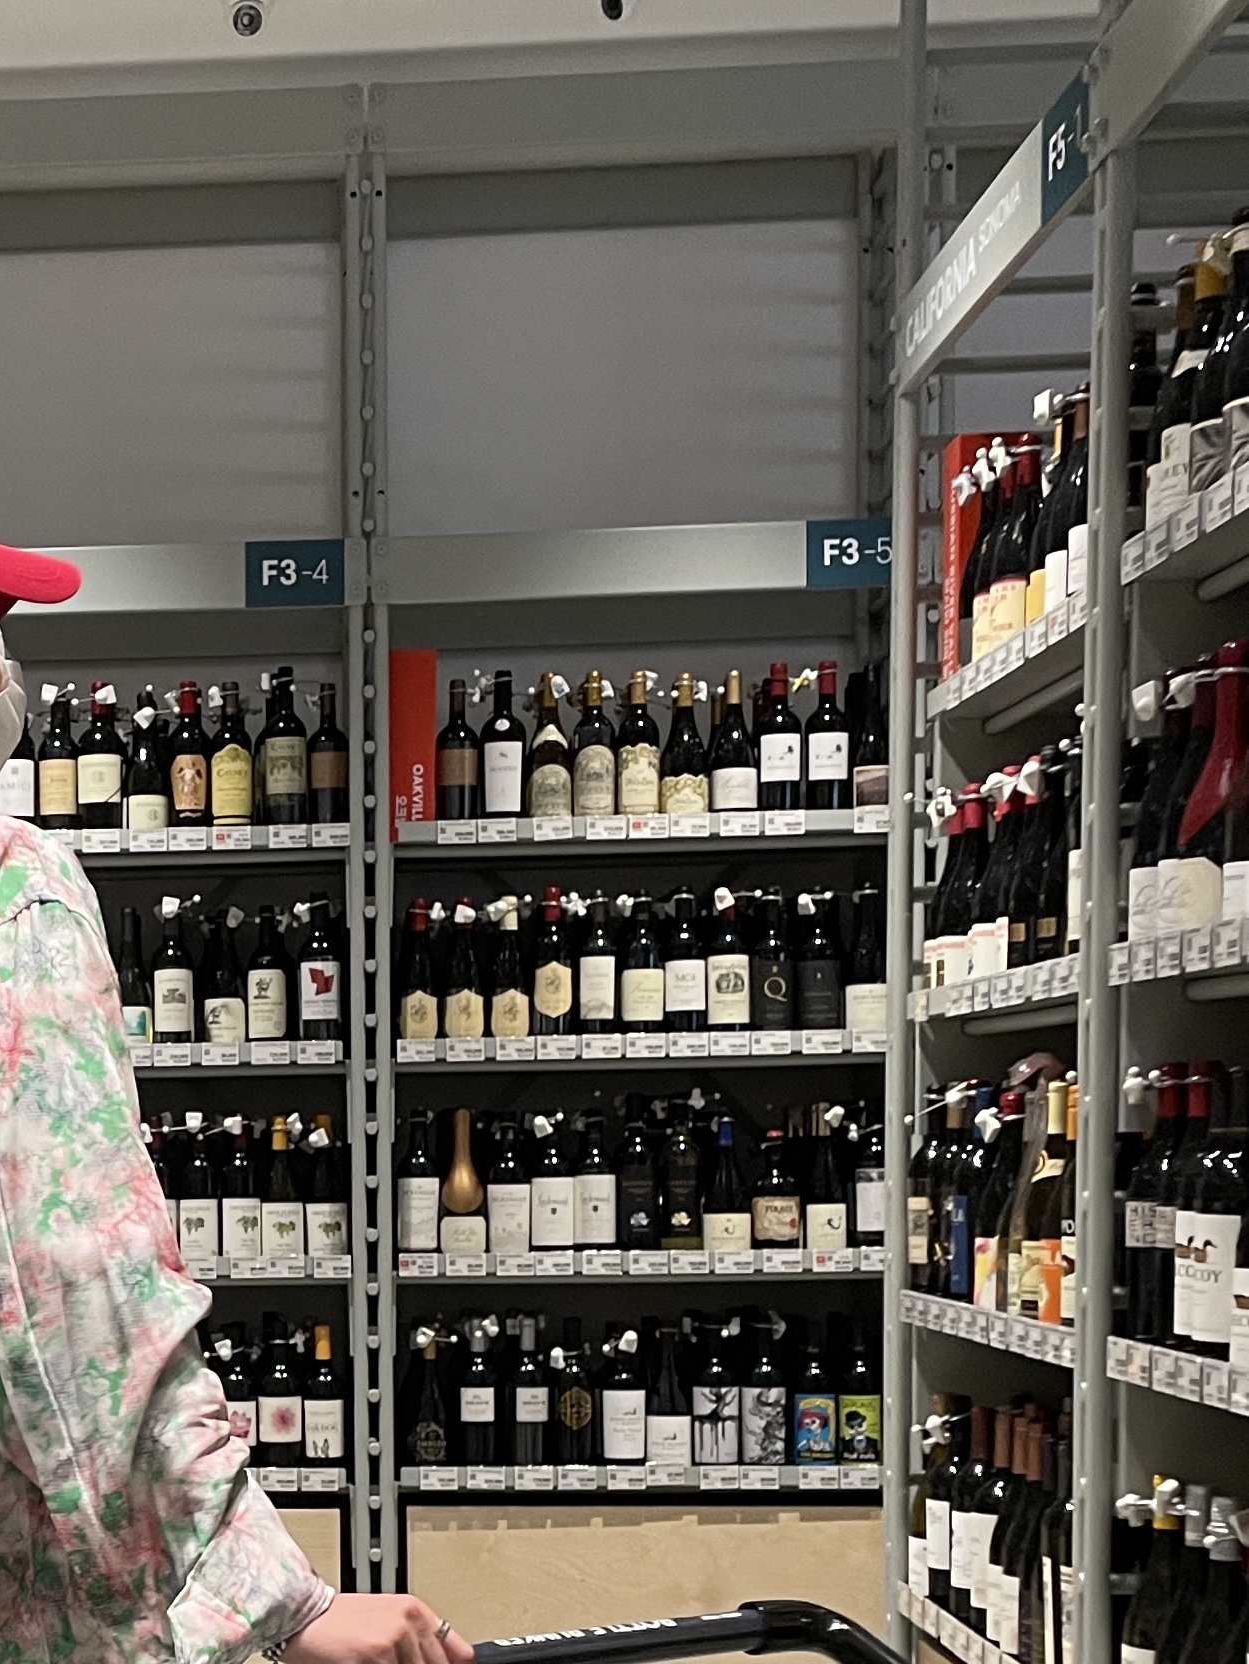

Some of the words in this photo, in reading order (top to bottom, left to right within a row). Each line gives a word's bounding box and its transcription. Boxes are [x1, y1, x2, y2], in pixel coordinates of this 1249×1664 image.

[904, 236, 977, 358] CALIFORNIA
[261, 558, 330, 586] F3-4
[823, 536, 892, 566] F3-5
[412, 763, 424, 821] OAKVILL
